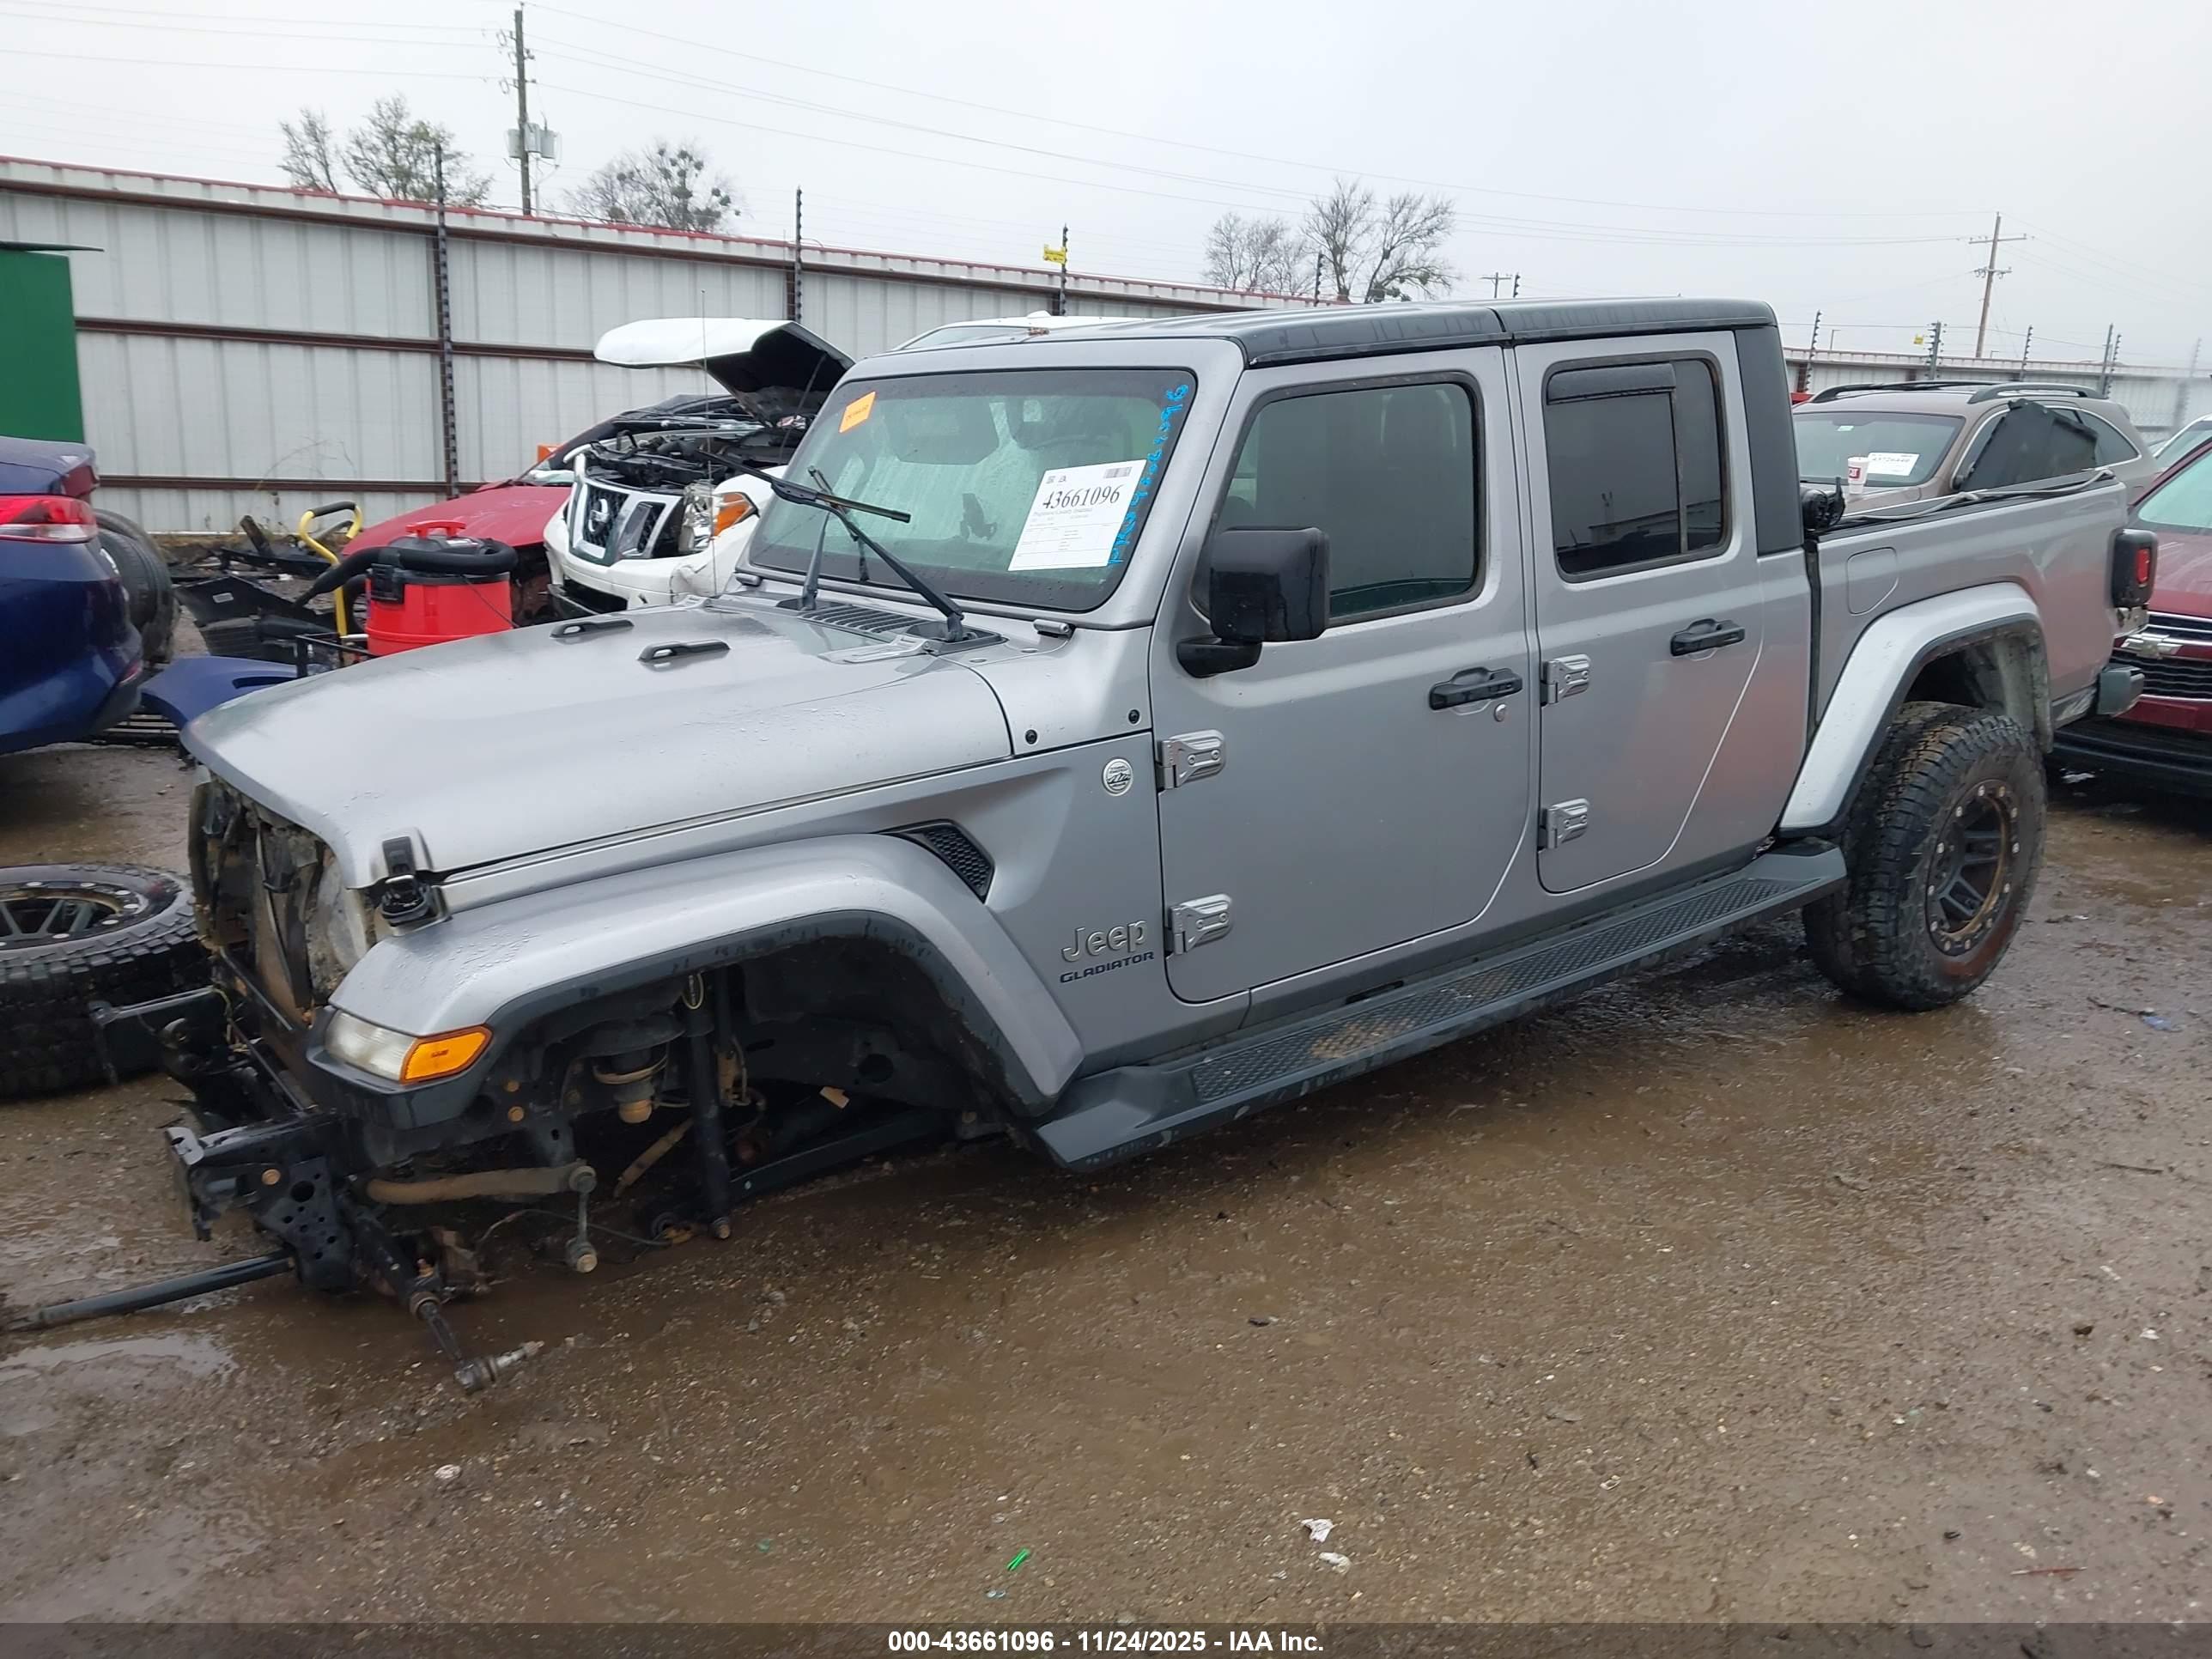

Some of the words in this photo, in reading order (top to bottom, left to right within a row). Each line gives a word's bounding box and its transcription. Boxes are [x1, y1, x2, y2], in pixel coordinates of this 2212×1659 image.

[1042, 483, 1125, 509] 43661096
[1061, 920, 1147, 963] Jeep
[1060, 951, 1155, 983] GLADIATOR
